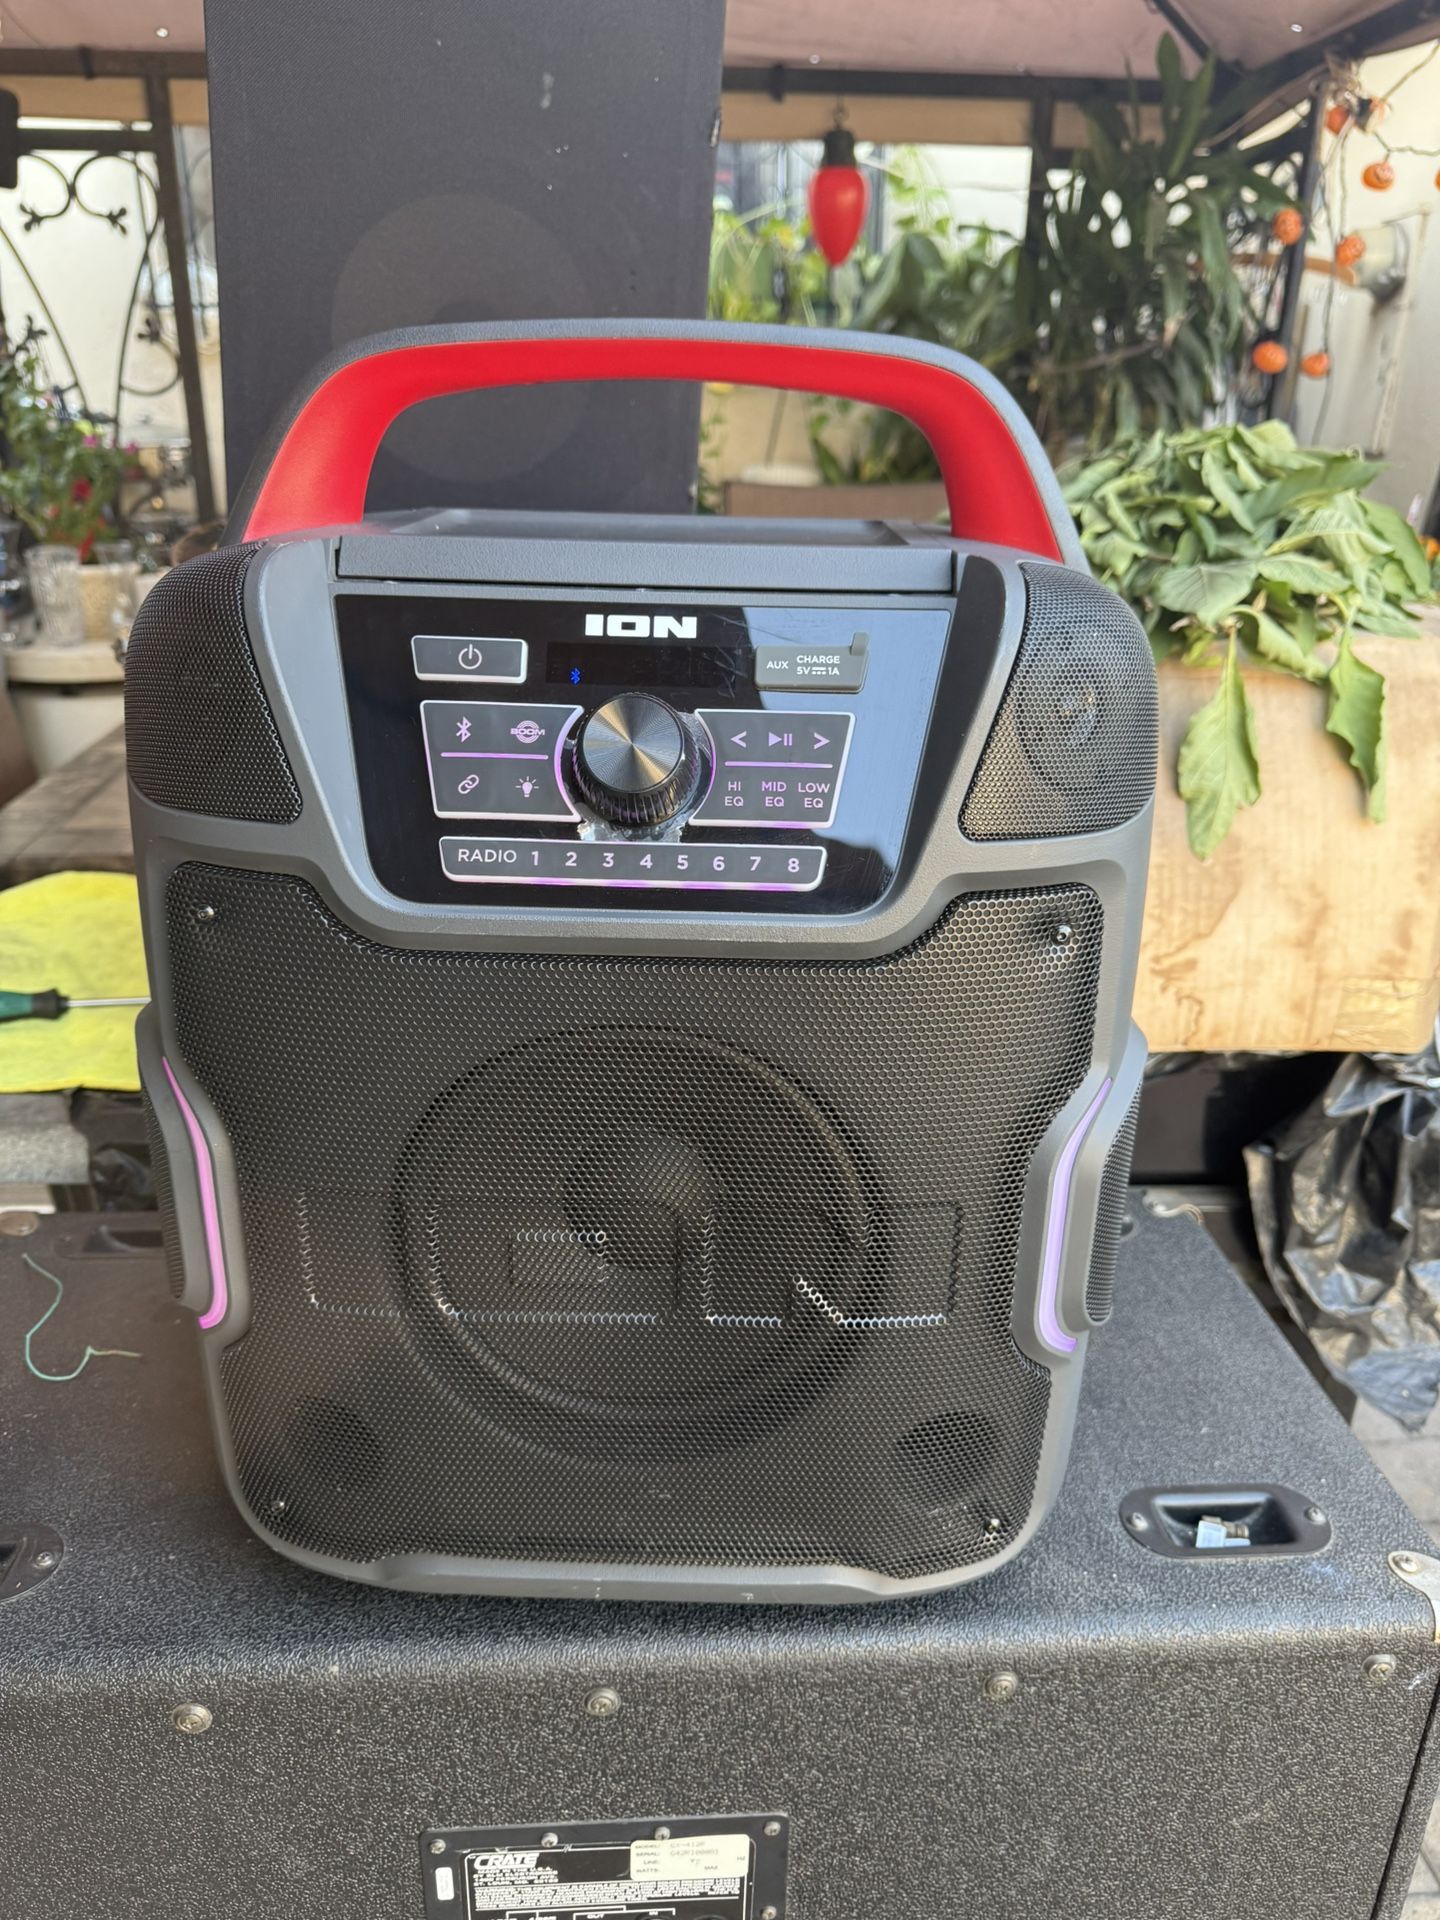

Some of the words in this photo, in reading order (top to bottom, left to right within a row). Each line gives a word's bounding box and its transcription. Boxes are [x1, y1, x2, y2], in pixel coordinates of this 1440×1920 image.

[584, 614, 697, 639] ION
[766, 660, 789, 669] AUX
[796, 655, 840, 664] CHARGE
[510, 727, 546, 736] BOOM
[727, 781, 742, 792] HI
[761, 781, 787, 792] MID
[797, 782, 831, 793] LOW
[724, 795, 744, 807] EQ
[765, 796, 785, 807] EQ
[804, 797, 824, 808] EQ
[458, 848, 517, 863] RADIO
[531, 850, 539, 866] 1
[564, 851, 577, 867] 2
[602, 852, 615, 868] 3
[639, 853, 653, 869] 4
[676, 854, 689, 870] 5
[712, 855, 725, 871] 6
[750, 856, 762, 871] 7
[787, 857, 800, 873] 8
[473, 1852, 540, 1870] CRATE
